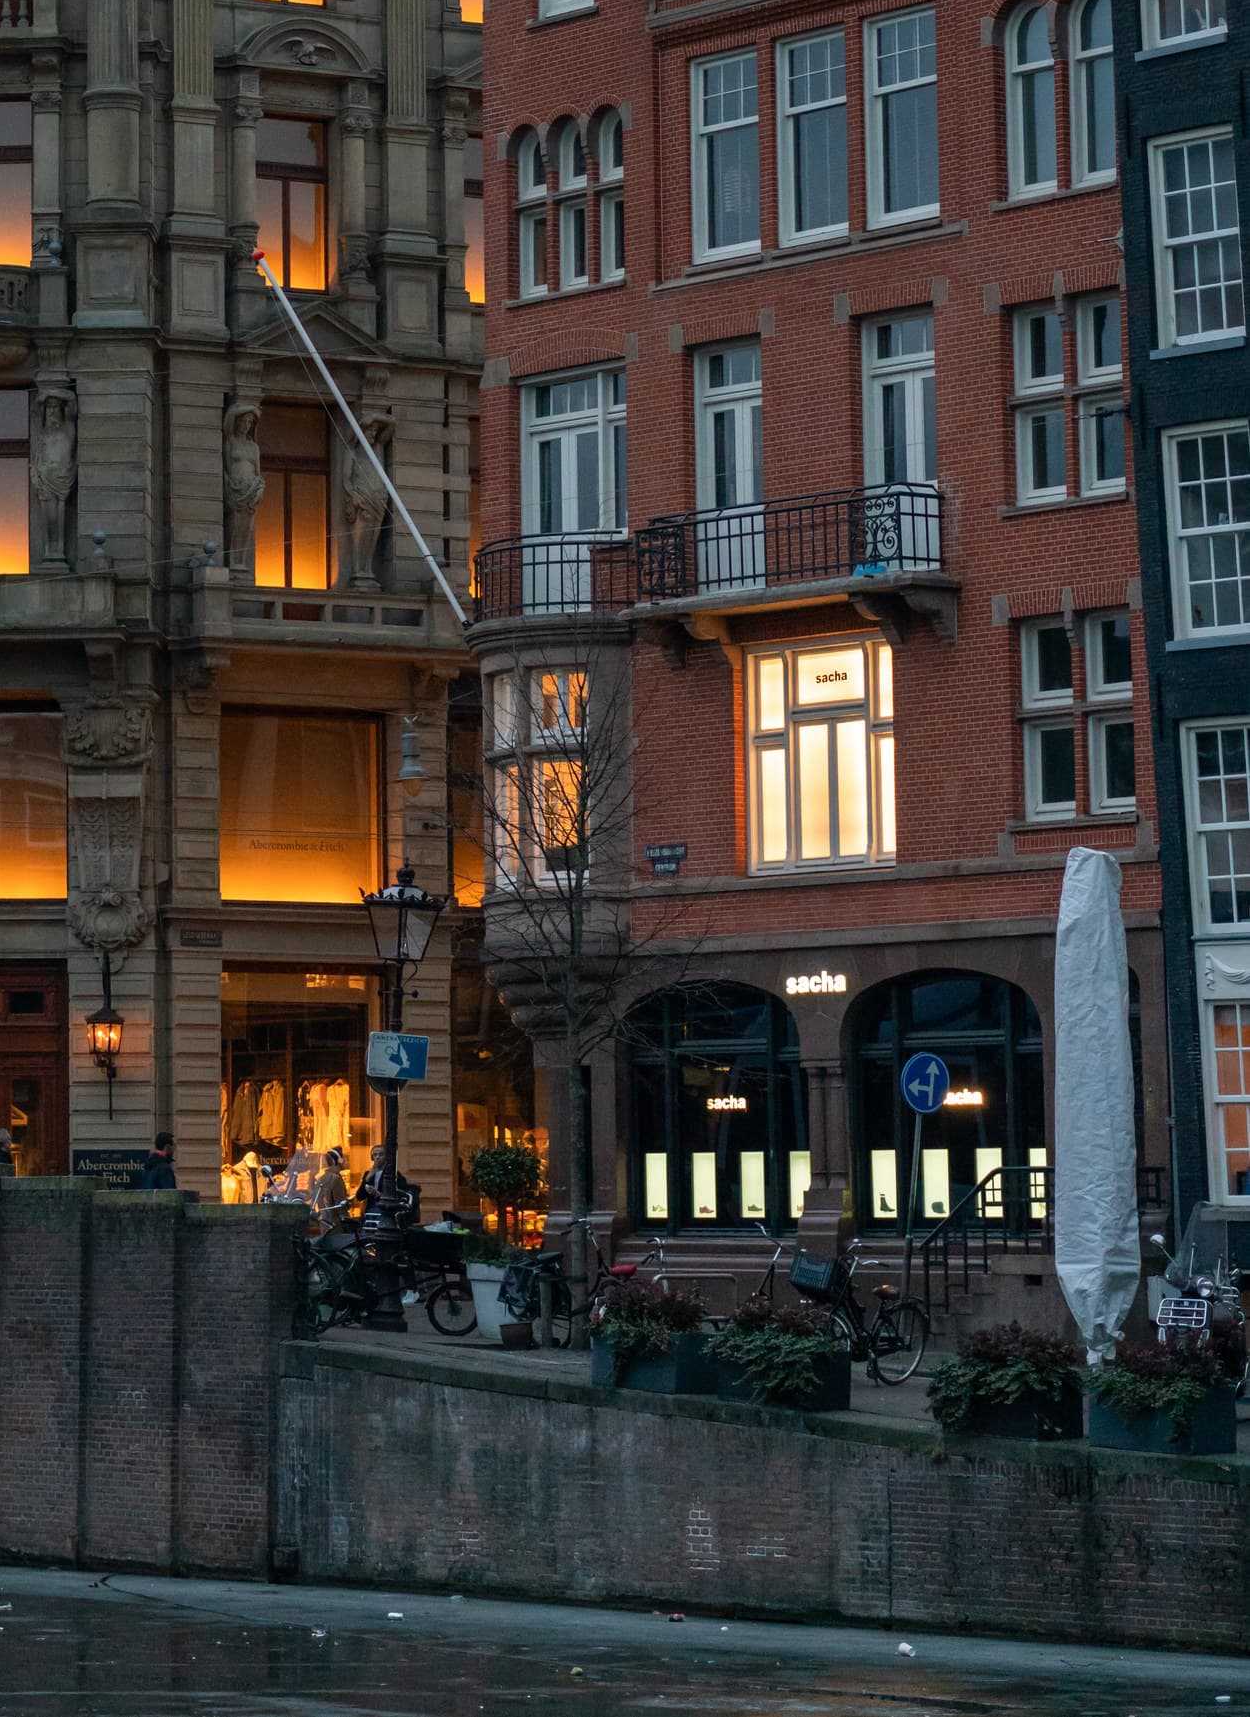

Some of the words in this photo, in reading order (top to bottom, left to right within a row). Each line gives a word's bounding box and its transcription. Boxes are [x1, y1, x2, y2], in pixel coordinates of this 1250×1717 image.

[816, 670, 847, 684] sacha
[252, 839, 309, 851] Abercrombie
[320, 840, 344, 852] Fitch
[786, 970, 847, 995] sacha
[706, 1093, 748, 1111] sacha
[943, 1088, 984, 1106] acha
[77, 1159, 146, 1171] Abercrombie
[102, 1171, 131, 1183] Fitch
